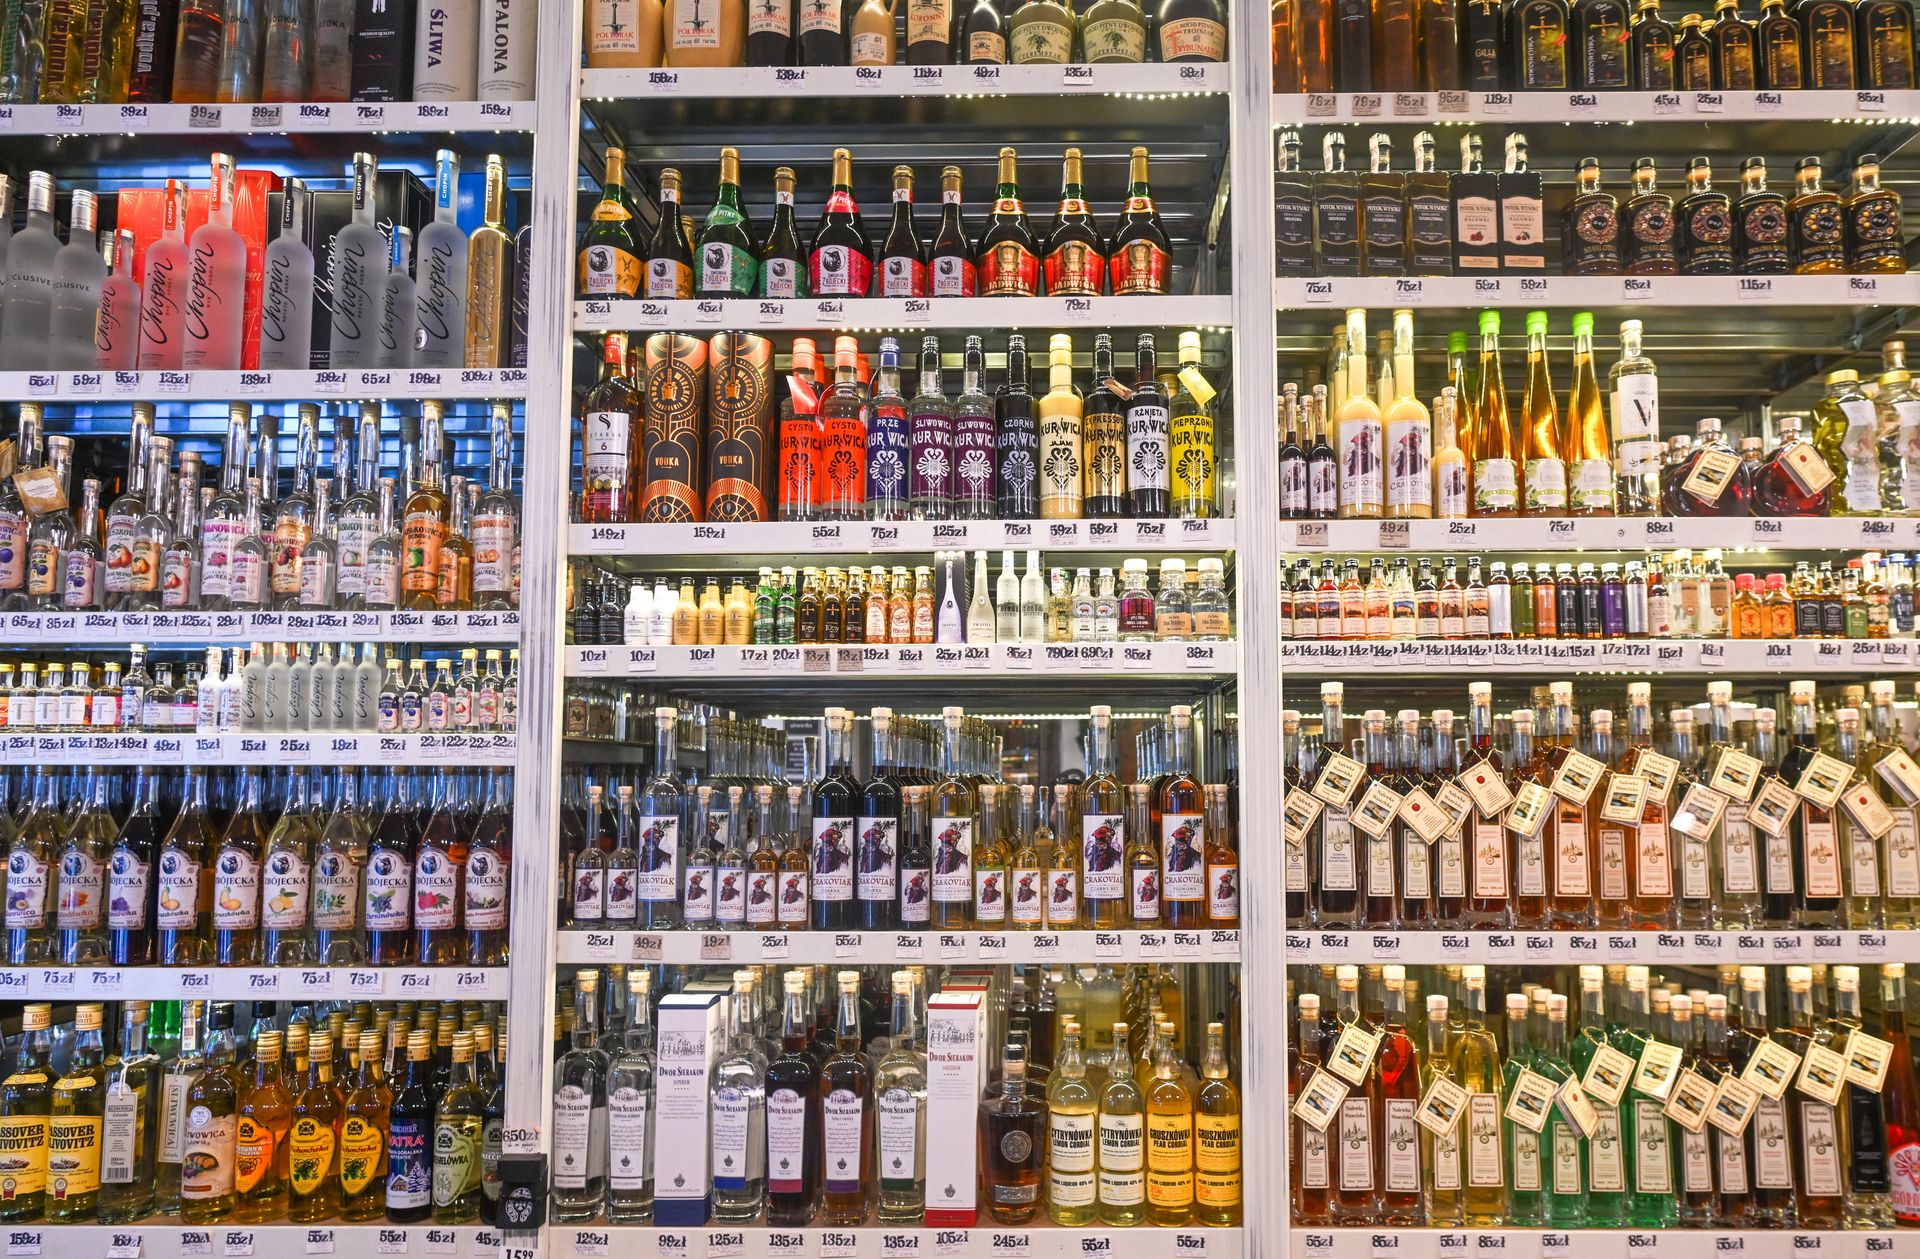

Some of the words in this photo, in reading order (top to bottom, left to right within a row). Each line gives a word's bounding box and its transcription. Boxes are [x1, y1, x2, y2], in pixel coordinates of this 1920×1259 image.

[428, 9, 444, 69] ŚLIWA
[649, 72, 678, 84] 159zł
[856, 67, 882, 78] 69zł
[974, 67, 1000, 78] 49zł
[1180, 67, 1205, 78] 89zł
[1309, 95, 1336, 106] 79zł
[1570, 95, 1597, 106] 85zł
[1654, 95, 1680, 106] 45zł
[1698, 93, 1723, 104] 25zł
[57, 106, 82, 117] 39zł
[121, 106, 148, 117] 39zł
[191, 107, 221, 120] 99zł
[480, 104, 511, 116] 159zł
[988, 281, 1030, 290] JADWIGA
[1053, 280, 1096, 290] JADWIGA
[1306, 282, 1332, 294] 75zł
[1397, 280, 1422, 292] 75zł
[1475, 280, 1500, 291] 59zł
[1625, 280, 1651, 291] 85zł
[1741, 279, 1771, 291] 115zł
[1851, 279, 1877, 290] 85zł
[186, 243, 221, 340] Chopin
[333, 242, 371, 340] Chopin
[416, 243, 458, 340] Chopin
[142, 257, 179, 344] Chopin
[262, 255, 297, 342] Chopin
[586, 302, 611, 314] 35zł
[818, 301, 843, 313] 45zł
[905, 300, 930, 312] 25zł
[1066, 299, 1091, 311] 79zł
[380, 284, 406, 350] Chopin
[73, 374, 100, 386] 59zł
[116, 372, 140, 384] 95zł
[160, 373, 188, 385] 125zł
[409, 372, 440, 385] 199zł
[462, 371, 492, 383] 309zł
[877, 419, 898, 428] PRZE
[601, 442, 607, 451] 6
[655, 457, 678, 466] VODKA
[720, 456, 742, 465] VODKA
[812, 526, 840, 537] 55zł
[933, 525, 967, 536] 125zł
[1182, 520, 1208, 532] 75zł
[1380, 522, 1409, 533] 49zł
[1450, 522, 1475, 534] 25zł
[1550, 521, 1575, 532] 75zł
[1647, 522, 1673, 533] 89zł
[1755, 521, 1781, 532] 59zł
[592, 528, 625, 540] 149zł
[871, 528, 898, 540] 75zł
[11, 615, 41, 627] 65zł
[46, 617, 75, 629] 35zł
[85, 615, 116, 627] 125zł
[432, 613, 457, 625] 45zł
[467, 614, 497, 626] 125zł
[581, 649, 606, 661] 10zł
[630, 650, 655, 661] 10zł
[773, 648, 800, 660] 20zł
[864, 649, 889, 660] 19zł
[899, 650, 922, 661] 16zł
[1187, 647, 1213, 659] 39zł
[1569, 645, 1595, 656] 15zł
[1627, 644, 1650, 656] 17zł
[10, 737, 35, 749] 25zł
[39, 738, 64, 749] 25zł
[120, 738, 147, 749] 49zł
[381, 738, 406, 750] 25zł
[763, 935, 787, 947] 25zł
[836, 935, 861, 946] 55zł
[1174, 934, 1201, 945] 55zł
[1212, 932, 1238, 943] 25zł
[1570, 937, 1597, 949] 85zł
[1610, 936, 1636, 948] 55zł
[44, 972, 73, 983] 75zł
[182, 974, 209, 986] 75zł
[401, 974, 429, 986] 75zł
[457, 973, 484, 984] 75zł
[1052, 1128, 1092, 1140] CYTRYNÓWKA
[1100, 1128, 1142, 1140] CYTRYNÓWKA
[1150, 1128, 1190, 1140] GRUSZKÓWKA
[1053, 1140, 1068, 1148] LEMON
[1070, 1140, 1090, 1148] CORDIAL
[1102, 1140, 1118, 1148] LEMON
[1119, 1140, 1140, 1148] CORDIAL
[1154, 1140, 1166, 1148] PEAR
[1167, 1140, 1187, 1148] CORDIAL
[1202, 1140, 1214, 1148] PEAR
[1216, 1140, 1236, 1148] CORDIAL
[10, 1233, 40, 1245] 159zł
[227, 1233, 253, 1245] 55zł
[380, 1231, 407, 1242] 55zł
[426, 1231, 455, 1242] 45zł
[769, 1234, 803, 1246] 135zł
[822, 1233, 856, 1245] 135zł
[1177, 1236, 1204, 1248] 55zł
[1306, 1236, 1333, 1246] 55zł
[1543, 1235, 1569, 1246] 55zł
[1629, 1236, 1656, 1247] 85zł
